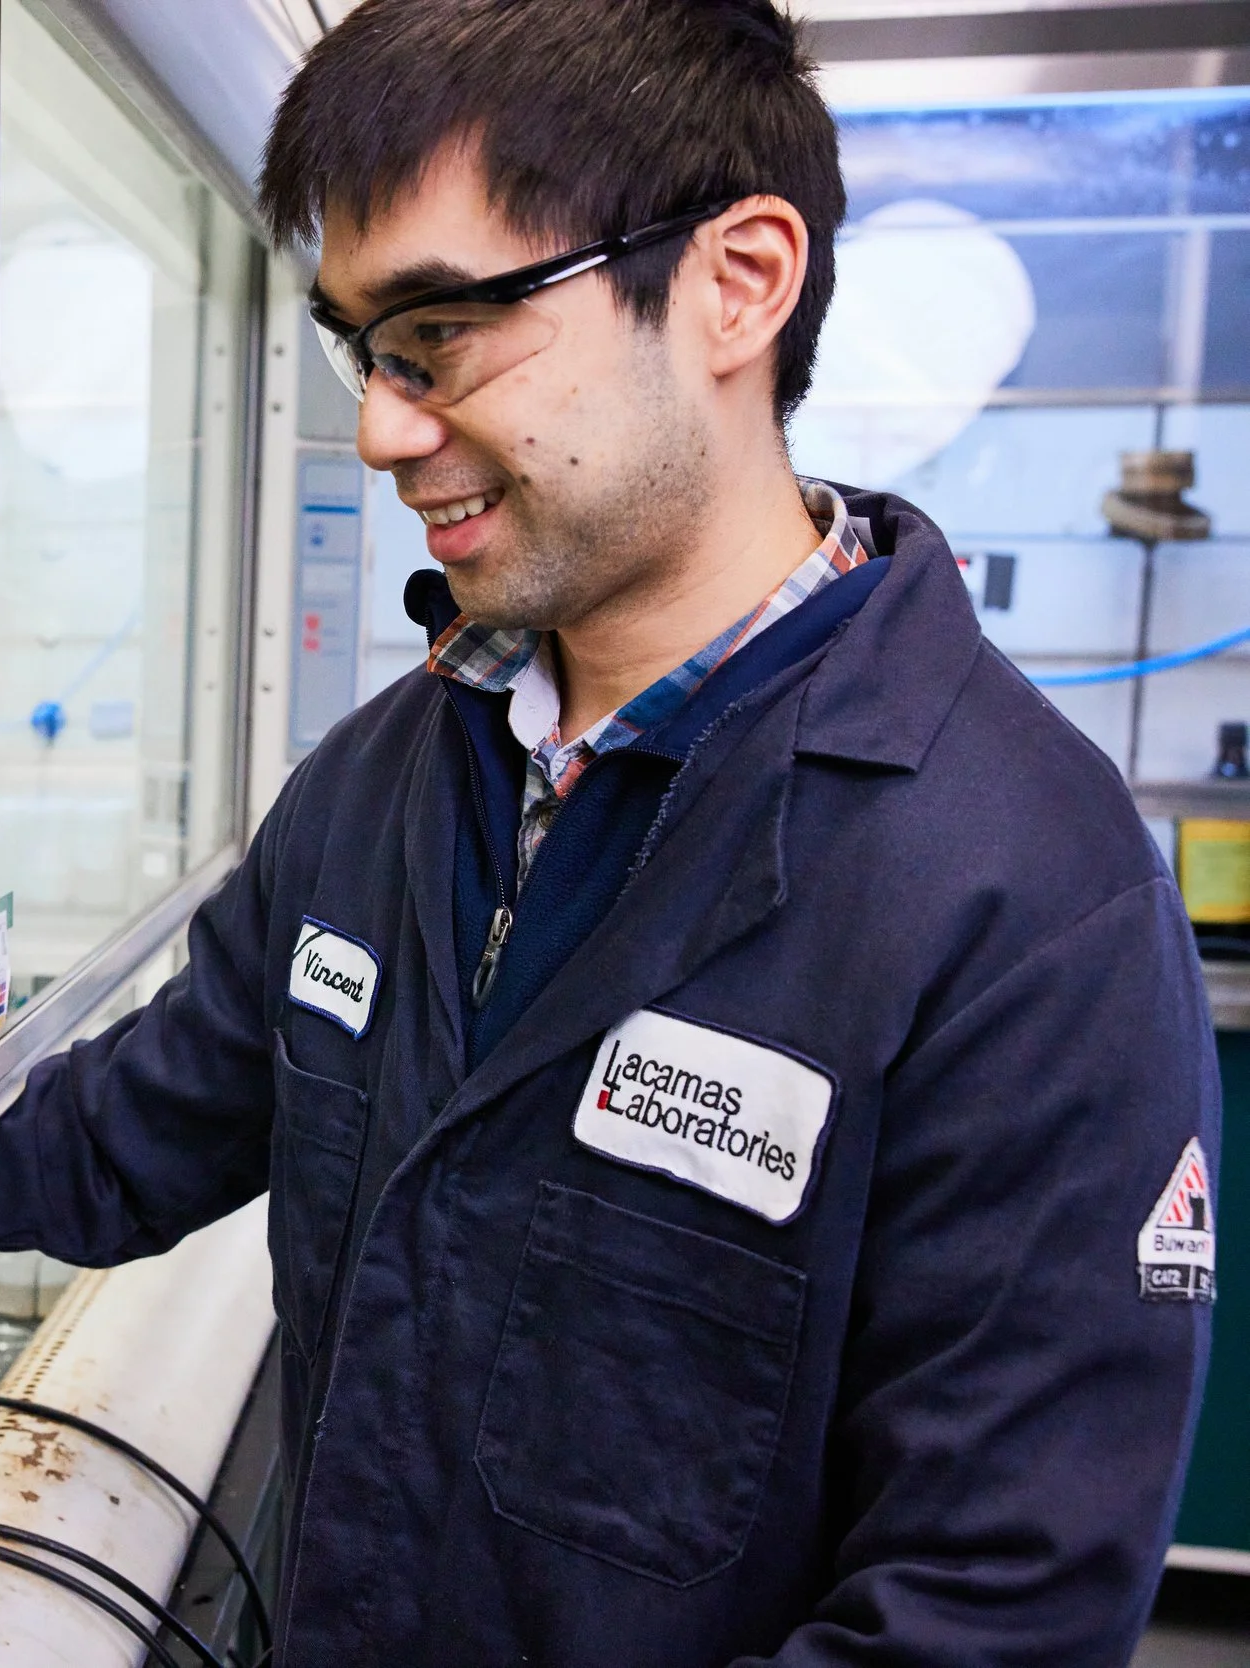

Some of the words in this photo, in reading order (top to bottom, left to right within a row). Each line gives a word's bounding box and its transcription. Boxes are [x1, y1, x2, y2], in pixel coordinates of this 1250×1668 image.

[303, 948, 365, 1003] Vincent
[602, 1039, 743, 1116] Lacamas
[605, 1064, 797, 1182] Laboratories
